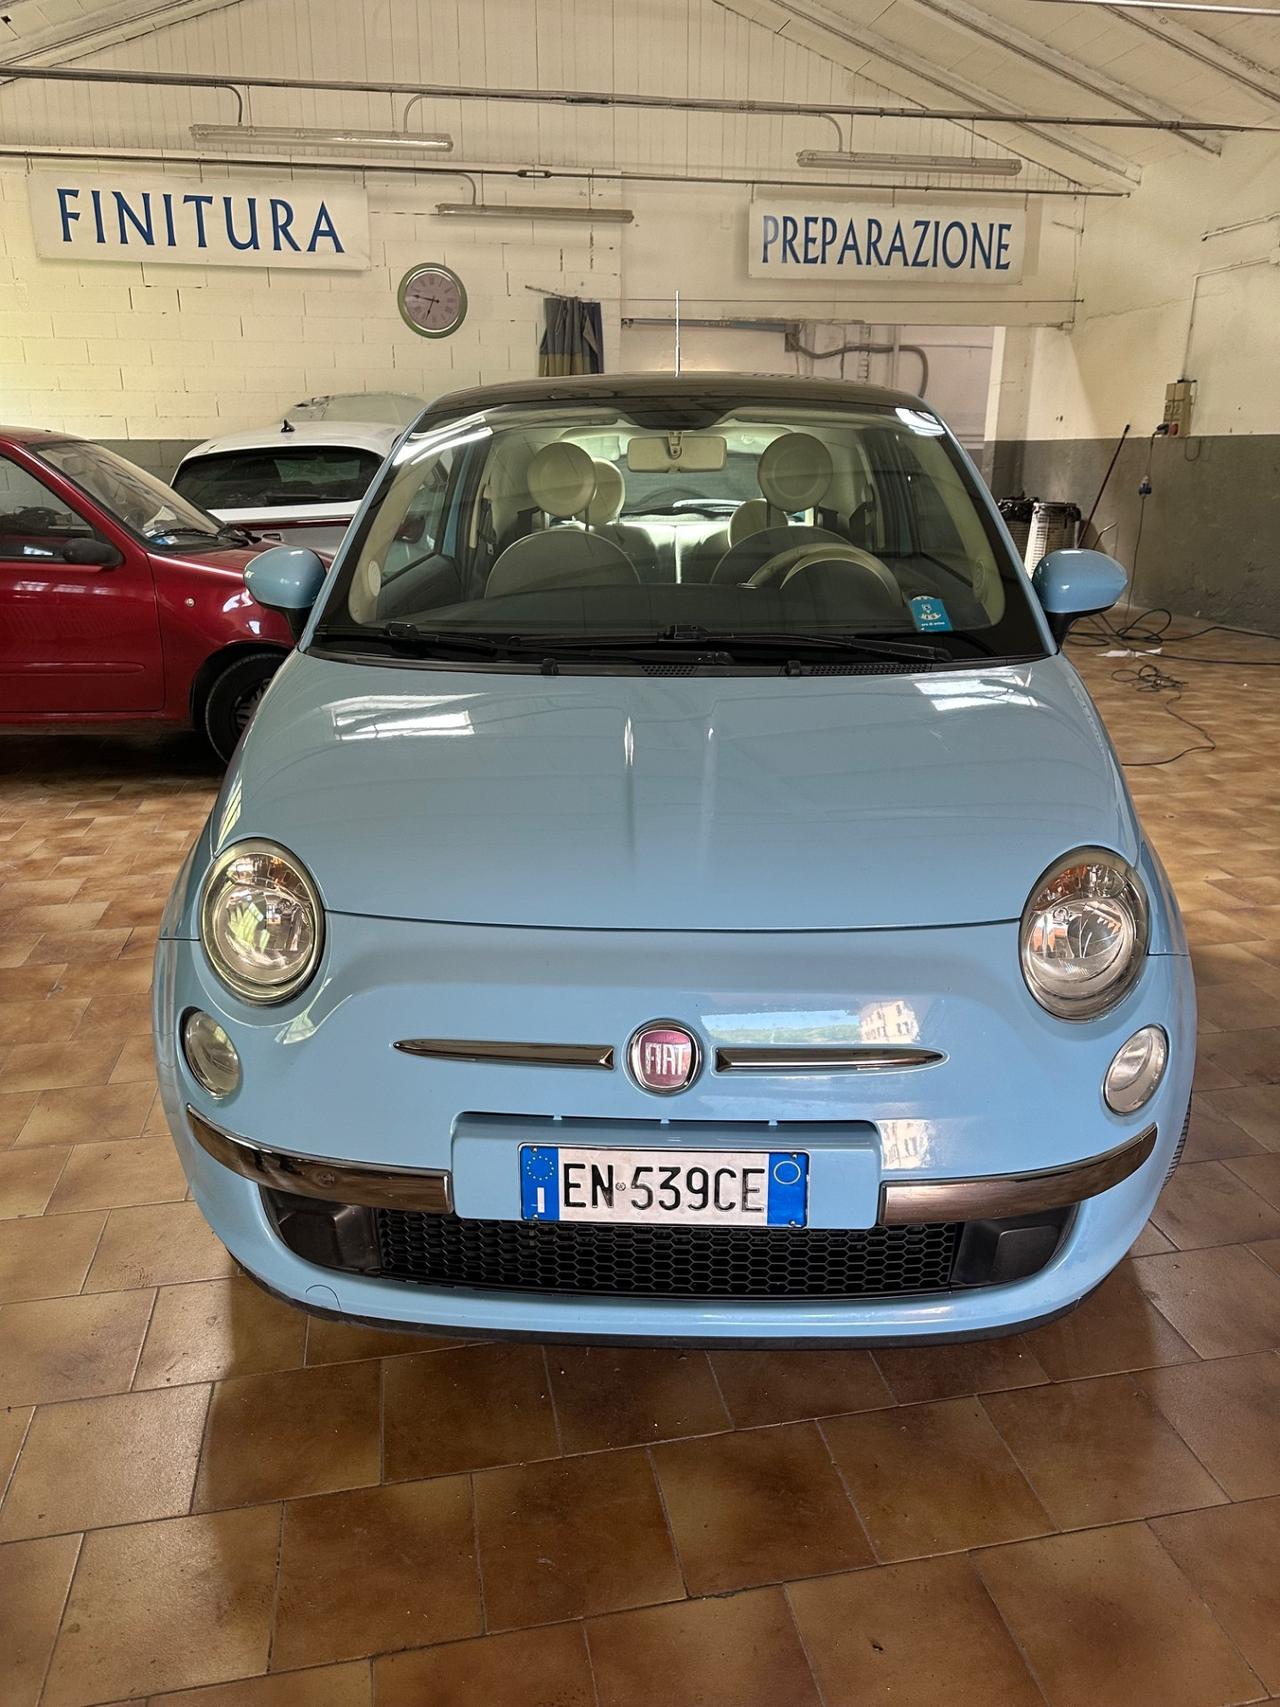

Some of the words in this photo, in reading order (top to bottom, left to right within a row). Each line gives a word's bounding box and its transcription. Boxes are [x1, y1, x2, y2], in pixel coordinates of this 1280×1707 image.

[57, 188, 345, 253] FINITURA
[762, 215, 1012, 270] PREPARAZIONE
[645, 1042, 691, 1075] FIAT
[564, 1163, 614, 1209] EN
[630, 1166, 765, 1213] 539CE
